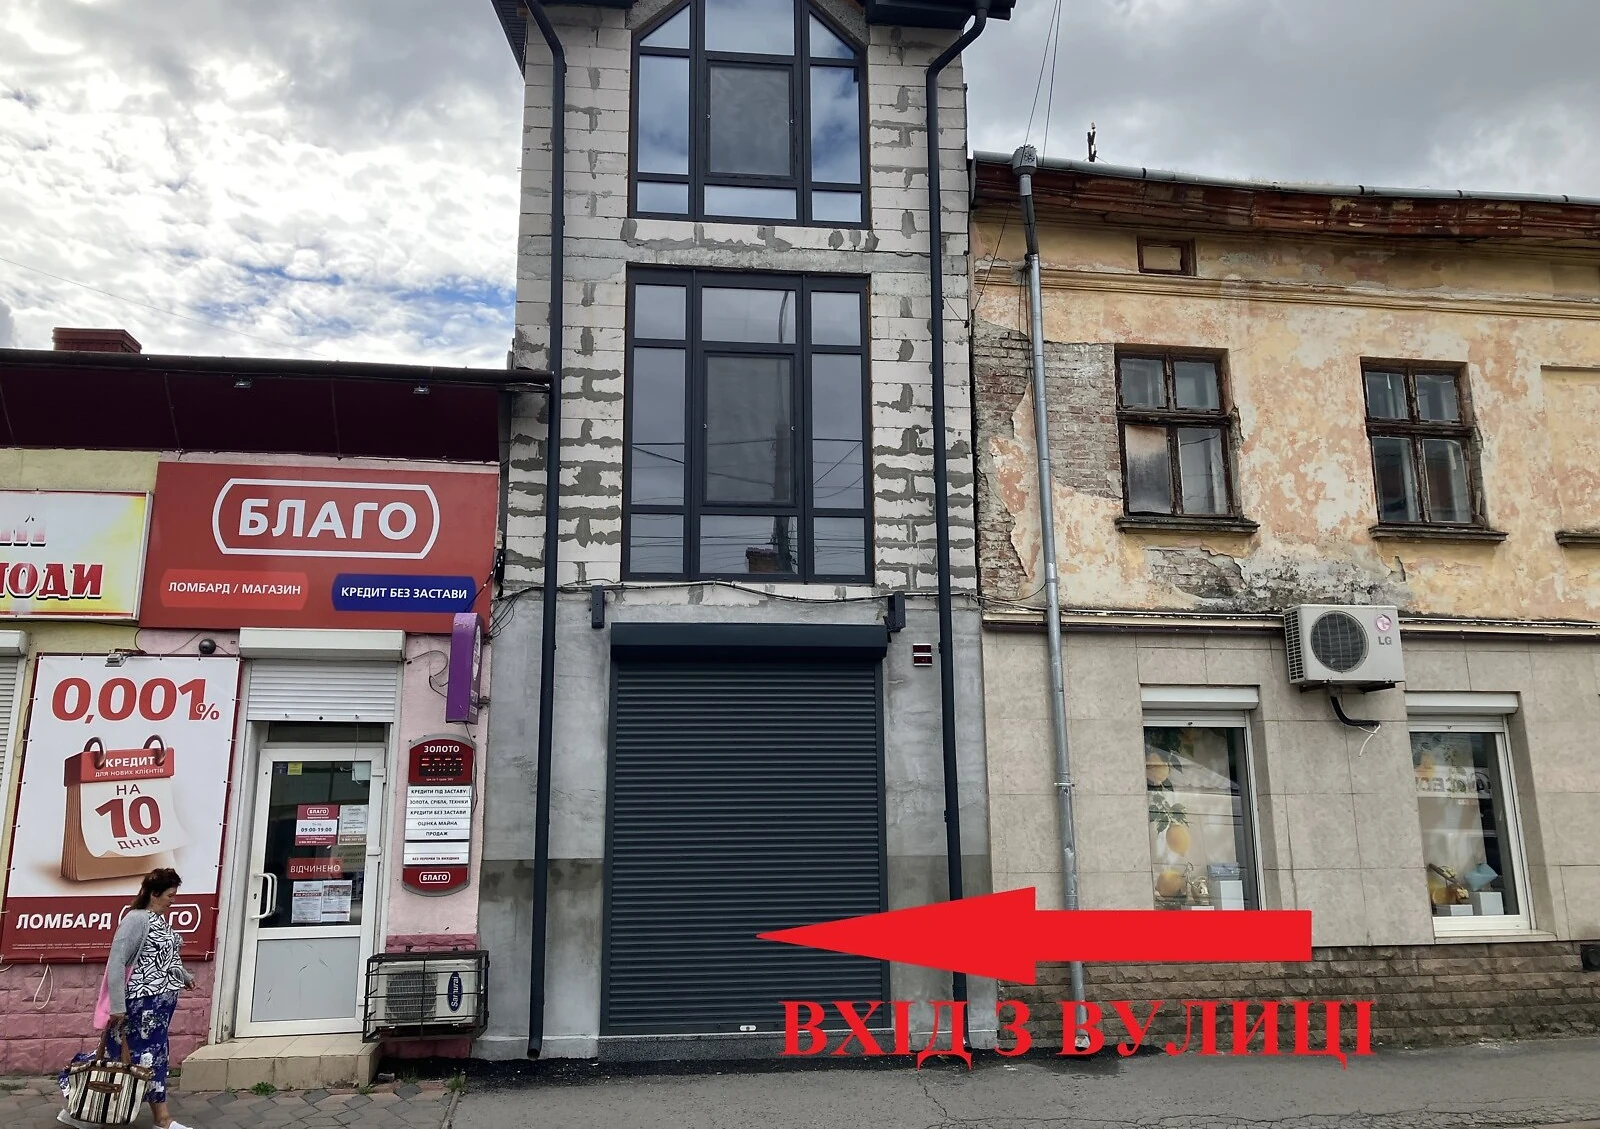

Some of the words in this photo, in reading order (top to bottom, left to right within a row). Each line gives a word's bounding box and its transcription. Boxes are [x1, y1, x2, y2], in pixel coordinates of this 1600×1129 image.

[238, 498, 417, 540] БЛАГО
[0, 562, 103, 600] ОДИ
[168, 581, 231, 596] ЛОМБАРД
[242, 583, 301, 596] МАГАЗИН
[341, 587, 387, 599] КРЕДИТ
[390, 588, 411, 599] БЕЗ
[413, 588, 468, 600] ЗАСТАВИ
[1378, 636, 1392, 646] LG
[423, 745, 460, 753] ЗОЛОТО
[105, 756, 155, 768] КРЕДИТ
[110, 769, 133, 777] нових
[134, 767, 164, 775] клієнтів
[116, 784, 141, 796] НА
[94, 795, 161, 839] 10
[117, 836, 161, 850] ДНІВ
[290, 864, 341, 873] ВІДЧИНЕНО
[15, 912, 112, 930] ЛОМБАРД
